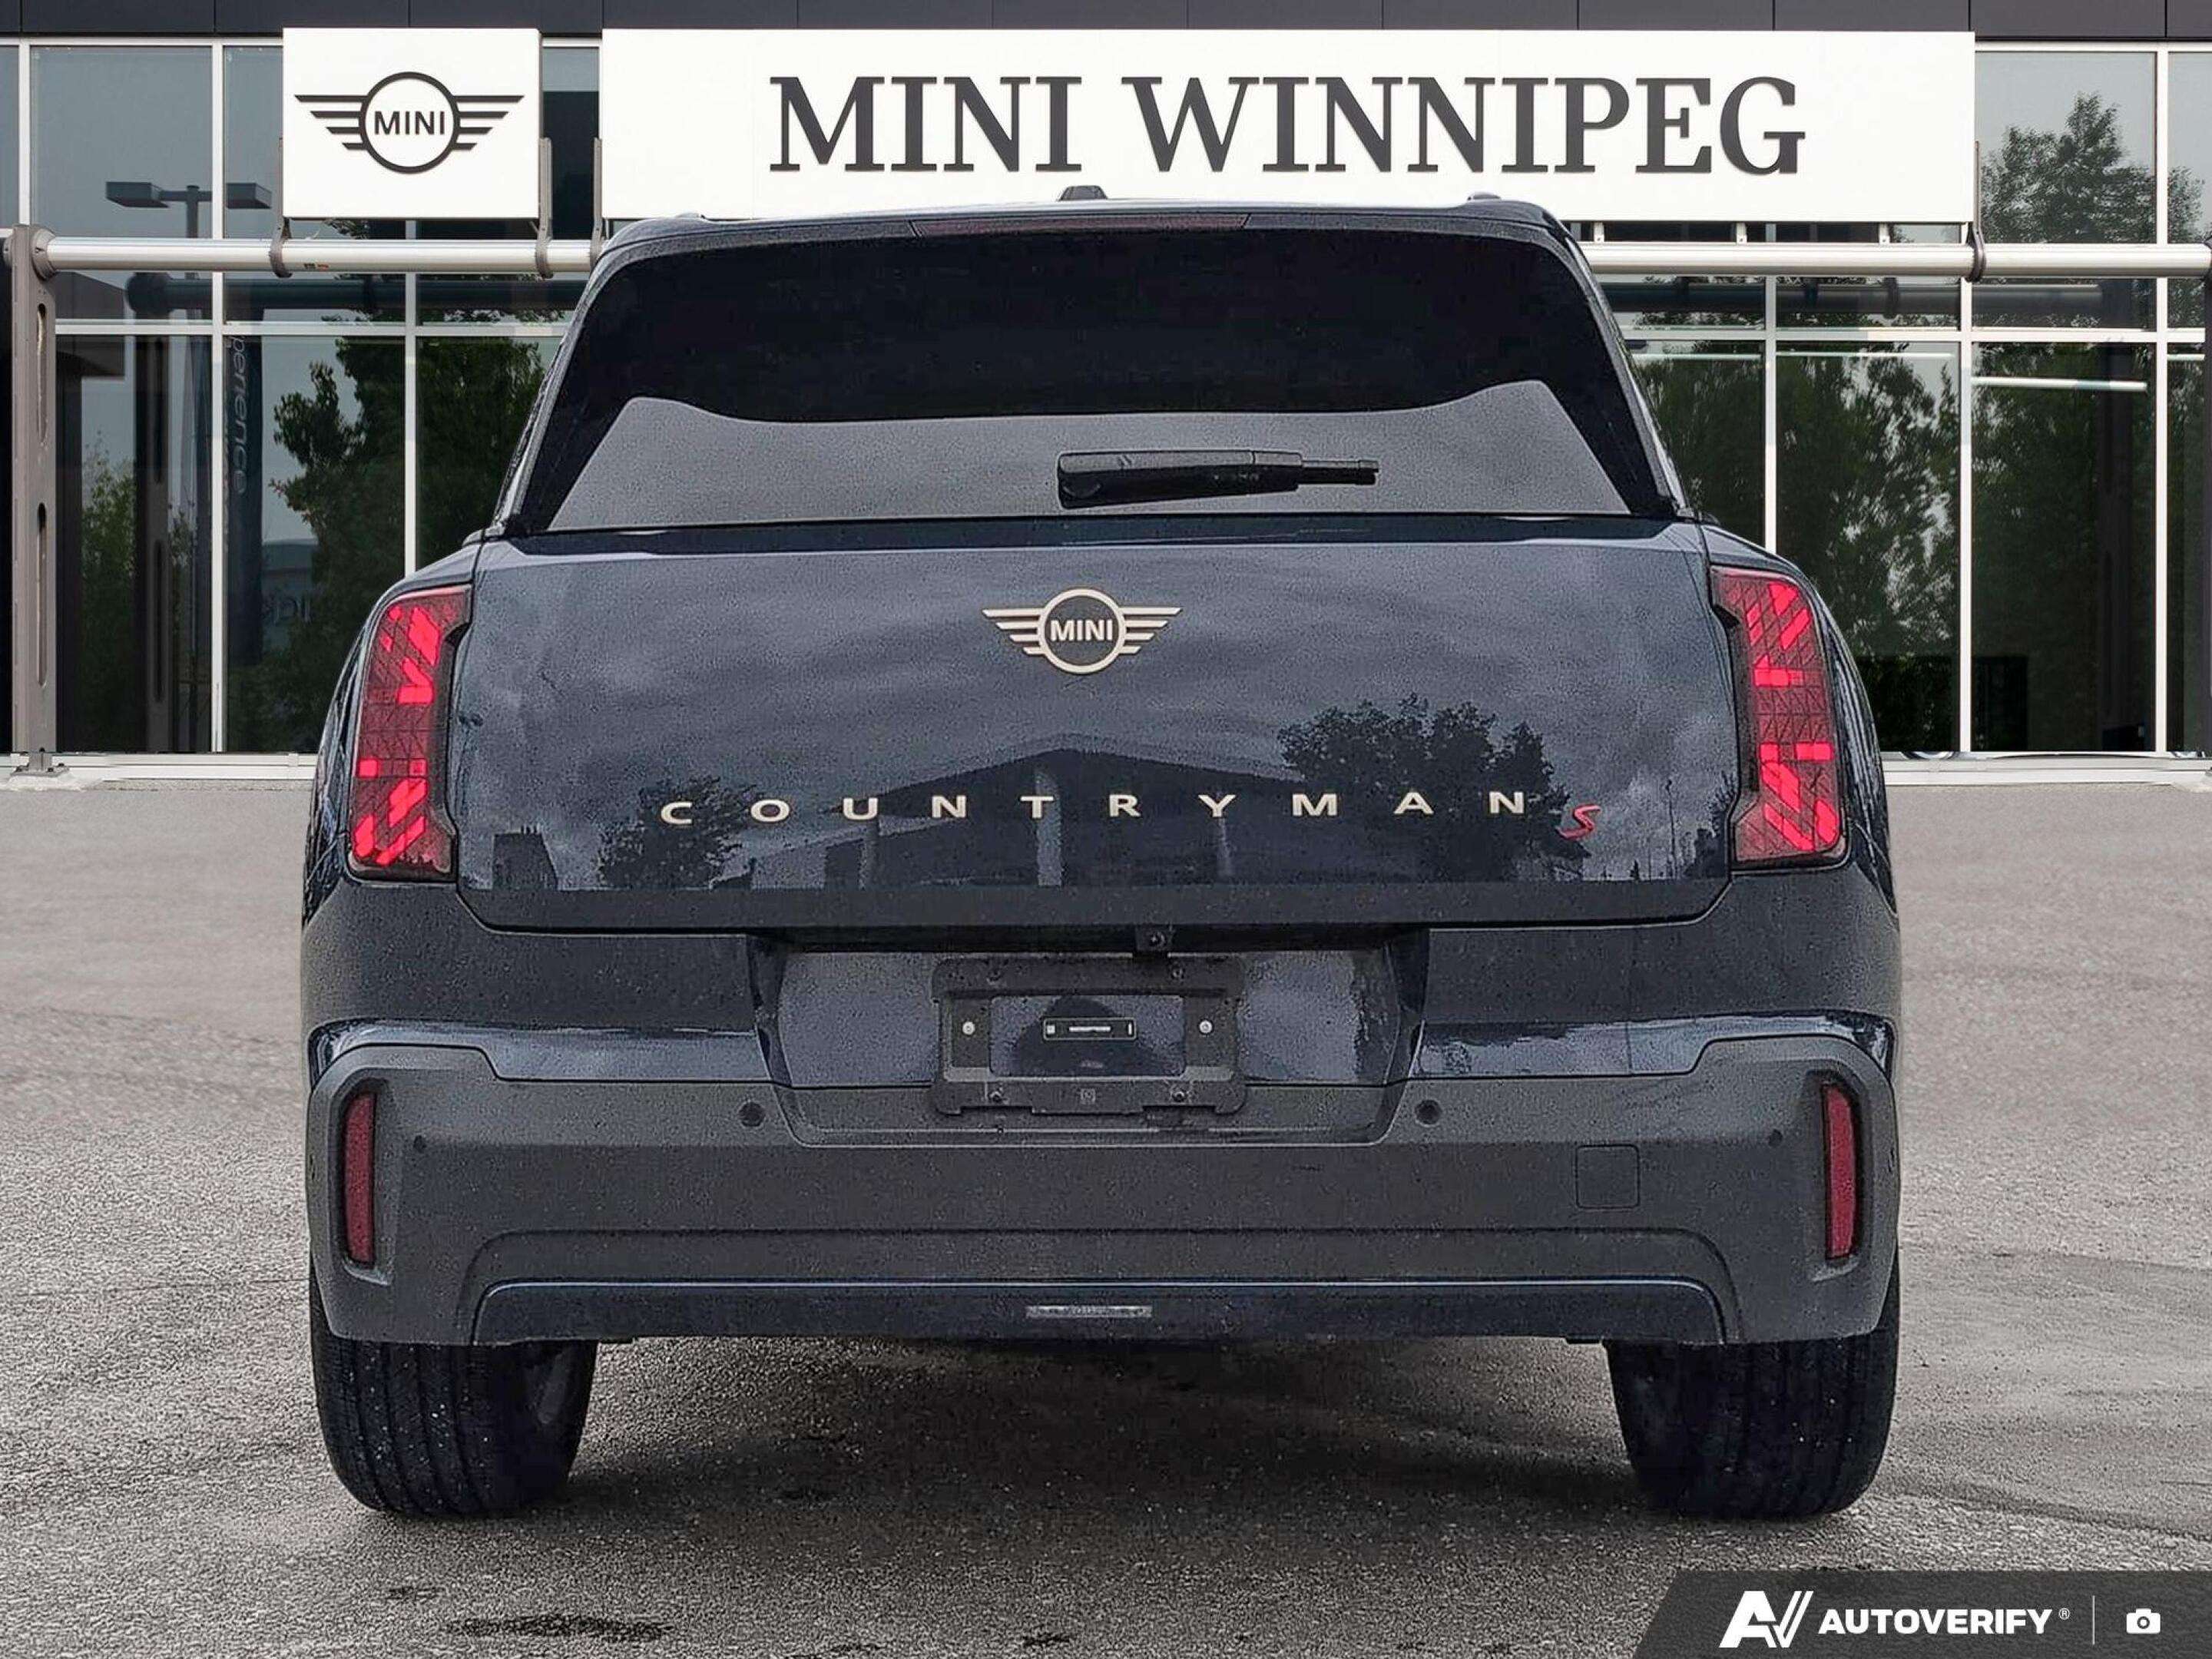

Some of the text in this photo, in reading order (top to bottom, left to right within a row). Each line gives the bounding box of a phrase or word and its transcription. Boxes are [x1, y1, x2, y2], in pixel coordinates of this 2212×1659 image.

[374, 111, 445, 135] MINI
[770, 76, 1806, 176] MINI WINNIPEG
[1050, 619, 1114, 641] MINI
[661, 791, 1601, 840] COUNTRYMAN S
